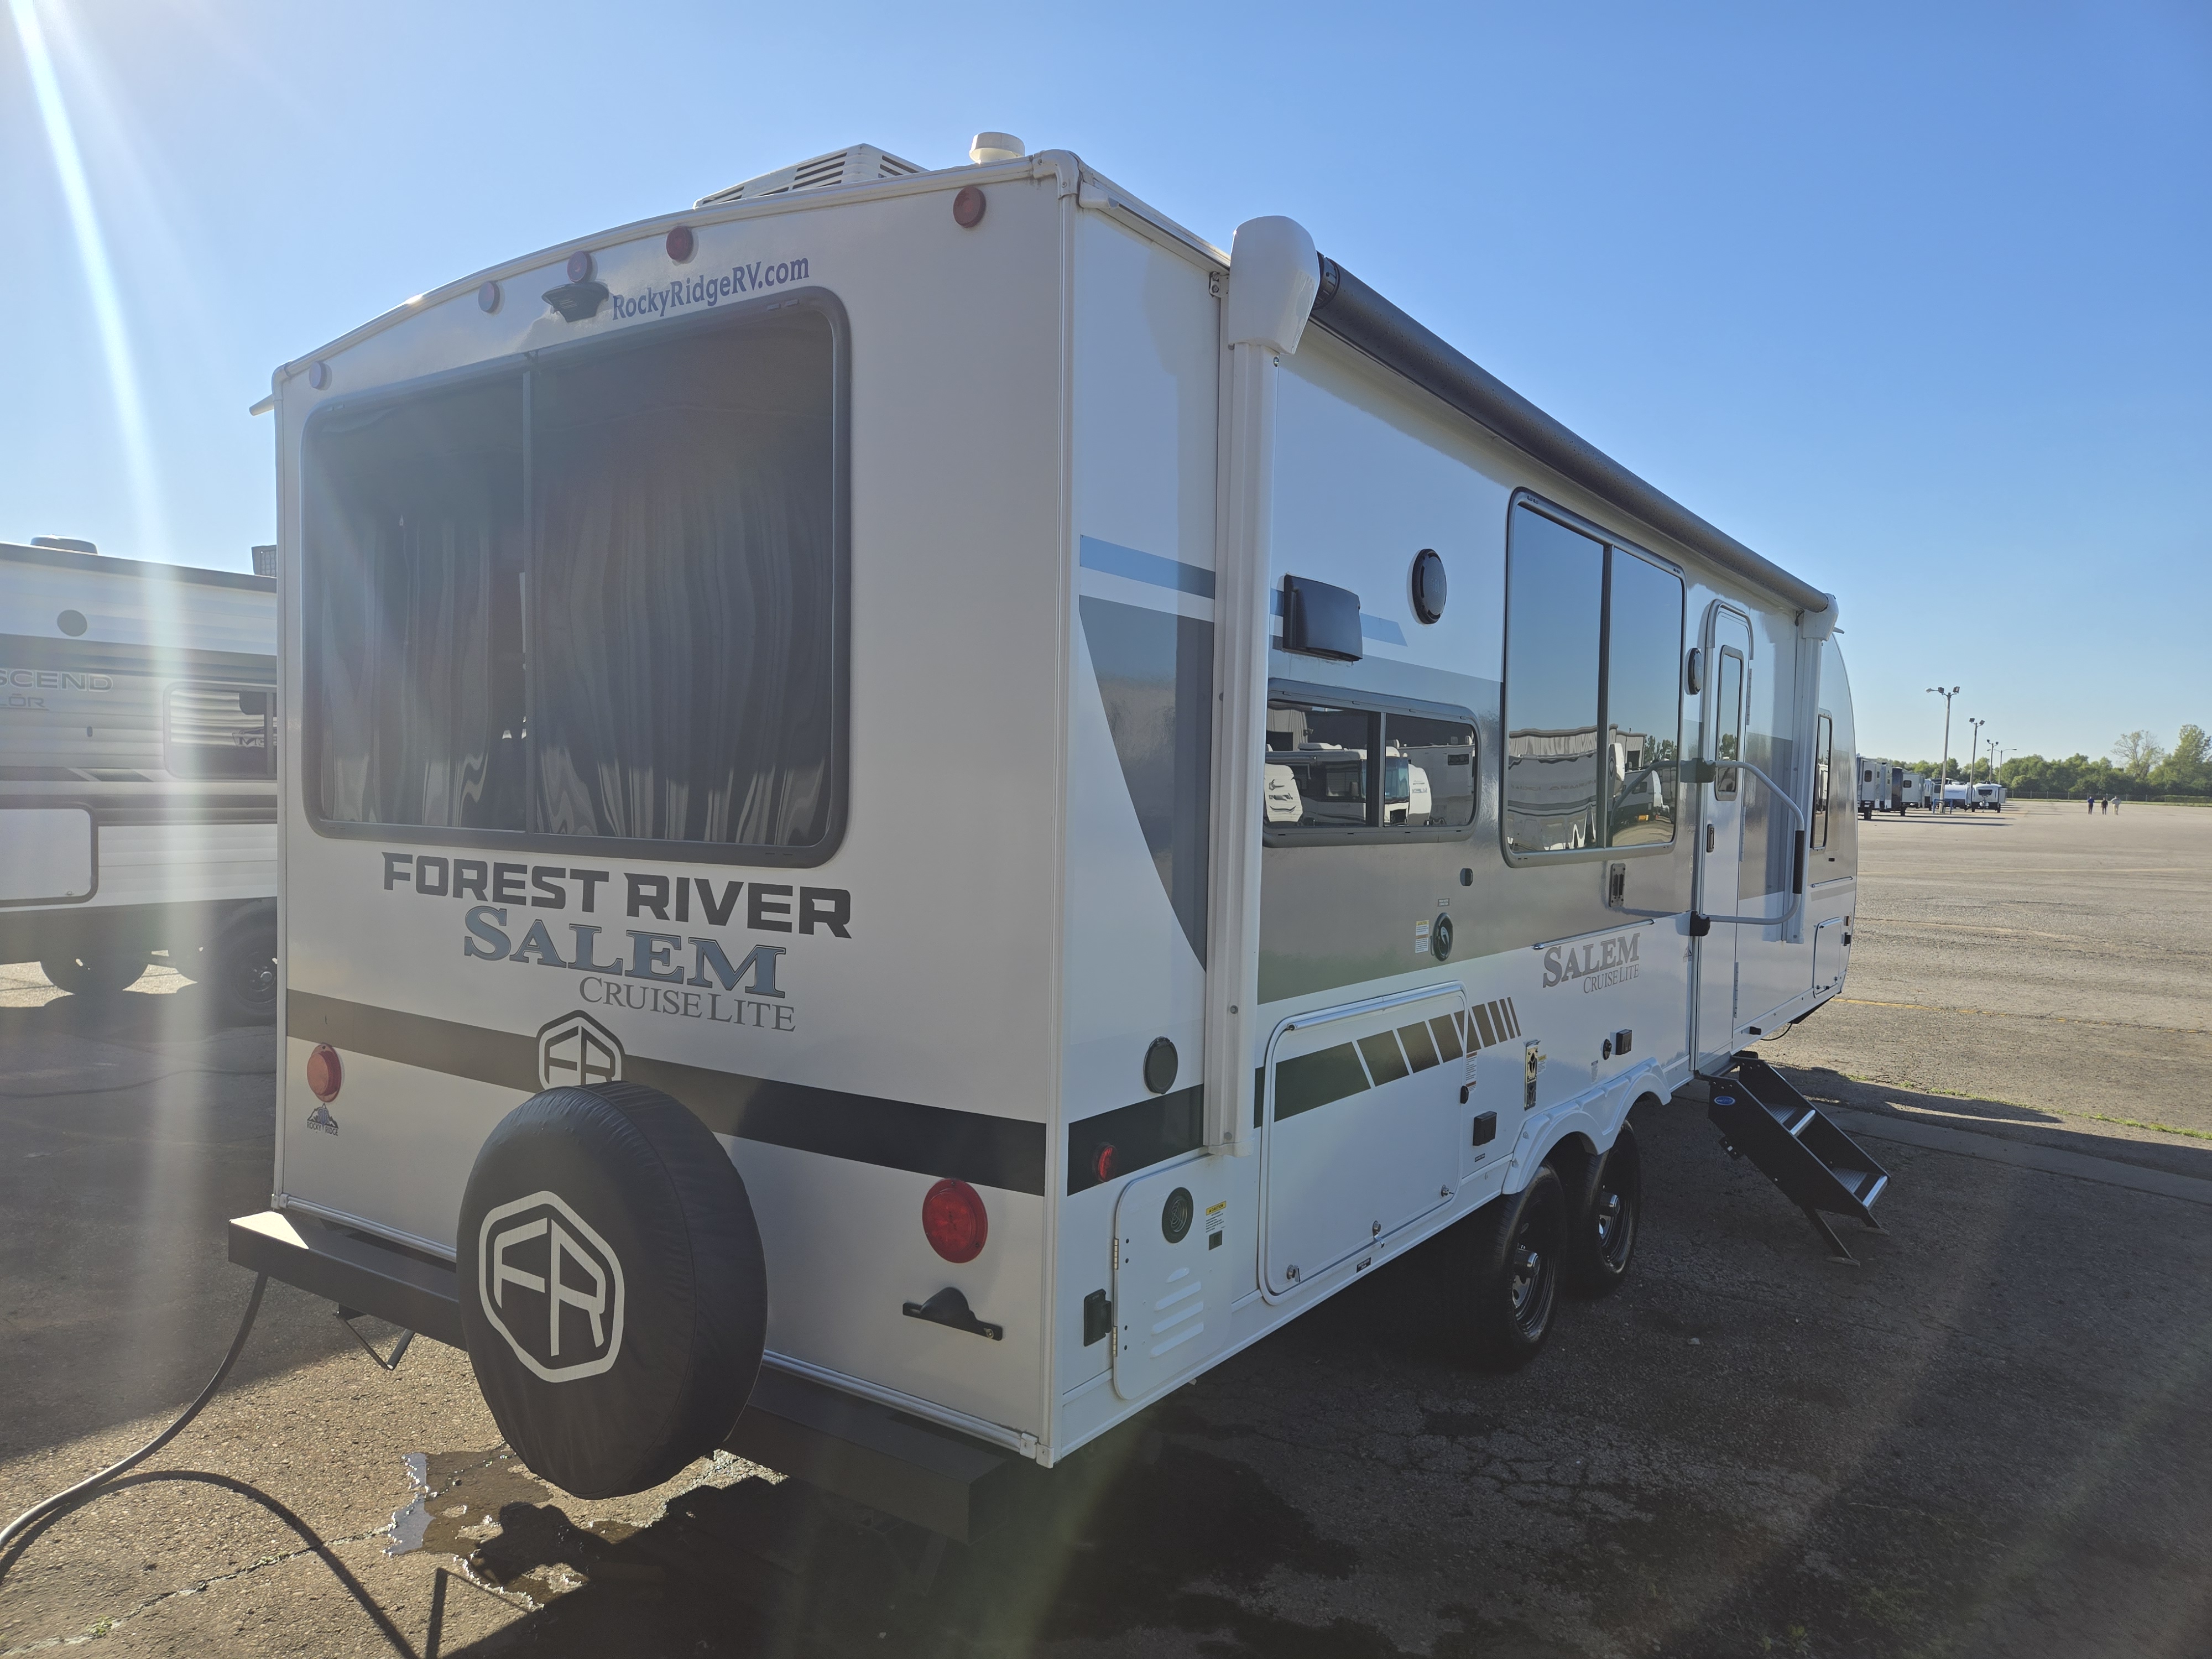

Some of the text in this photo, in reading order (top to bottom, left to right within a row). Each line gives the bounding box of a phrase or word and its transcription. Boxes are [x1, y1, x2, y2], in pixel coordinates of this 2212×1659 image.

[612, 257, 810, 320] RockyRidgeRV.com
[382, 852, 852, 938] FOREST RIVER
[463, 905, 787, 999] SALEM
[1542, 932, 1640, 988] SALEM
[306, 1121, 338, 1136] ROCKY RIDGE
